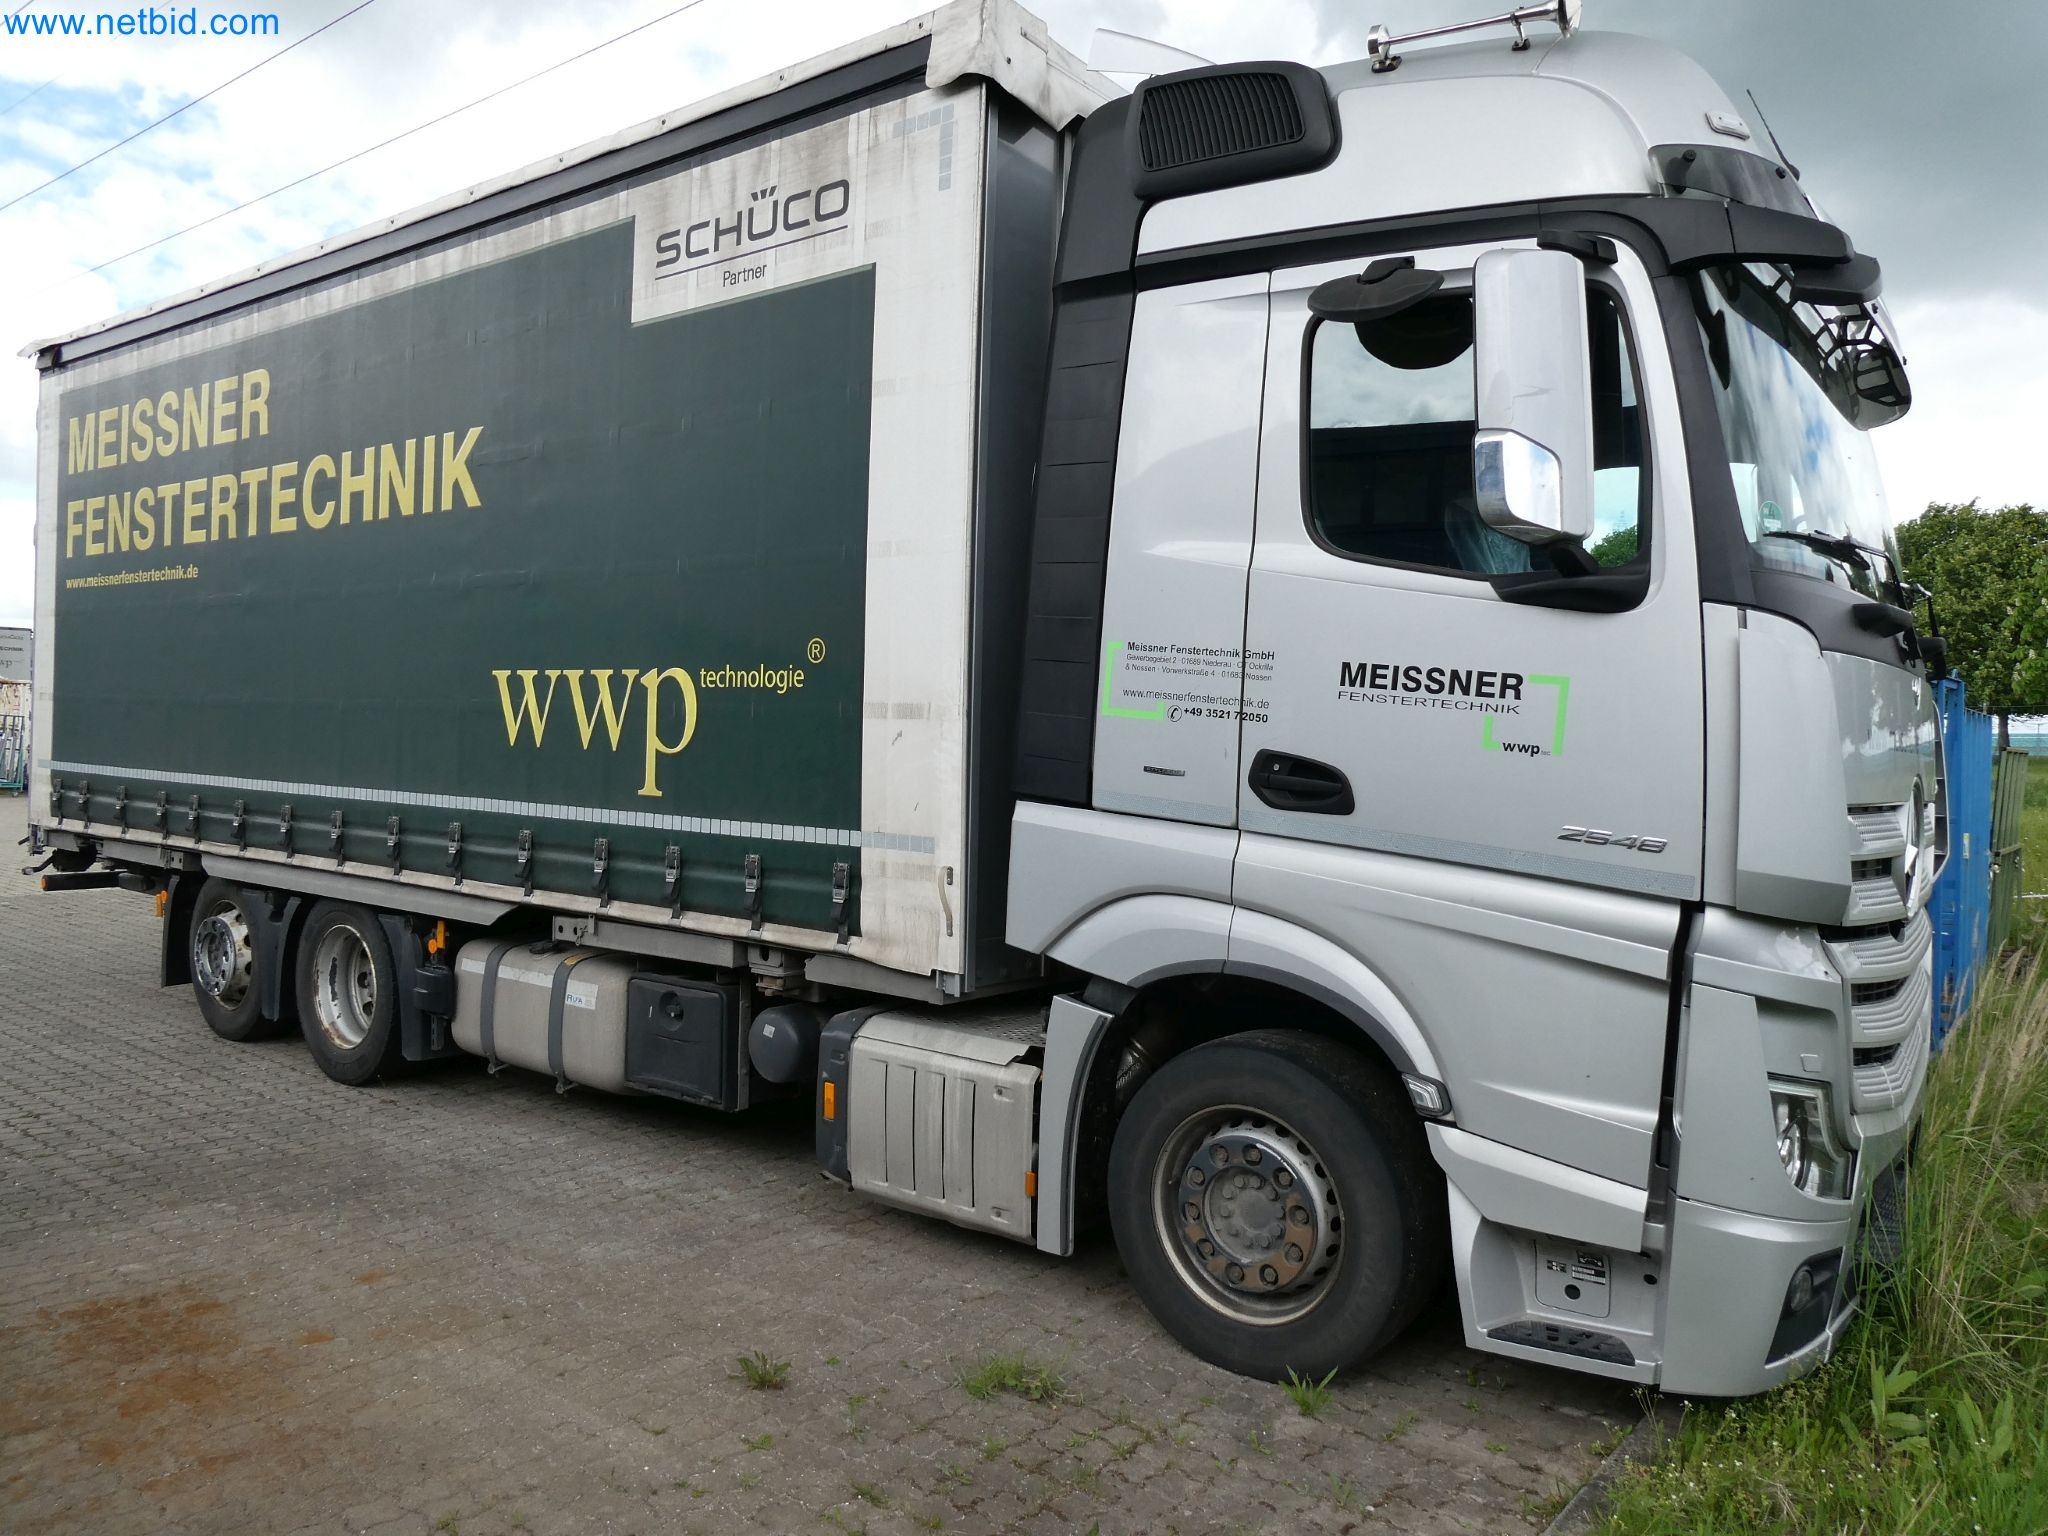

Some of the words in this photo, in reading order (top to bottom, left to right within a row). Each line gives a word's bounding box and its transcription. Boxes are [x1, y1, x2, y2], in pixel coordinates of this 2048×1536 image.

[655, 179, 850, 269] SCHÜCO
[722, 264, 767, 288] Partner
[68, 368, 272, 475] MEISSNER
[66, 426, 484, 559] FENSTERTECHNIK
[66, 564, 199, 589] www.meissnerfenstertechnik.de
[1127, 641, 1168, 653] Meissner
[1170, 644, 1240, 658] Fenstertechnik
[1244, 649, 1275, 660] GmbH
[1131, 663, 1156, 673] Nossen
[1245, 673, 1272, 681] Nossen
[1339, 661, 1524, 701] MEISSNER
[1122, 688, 1270, 709] www.meissnerfenstertechnik.de
[1338, 691, 1521, 715] FENSTERTECHNIK
[1183, 707, 1203, 717] +49
[1205, 708, 1231, 720] 3521
[1234, 711, 1268, 723] 72050
[492, 667, 698, 797] wwp
[700, 664, 804, 694] technologie
[1502, 742, 1540, 757] wwp
[1557, 825, 1668, 854] 2548
